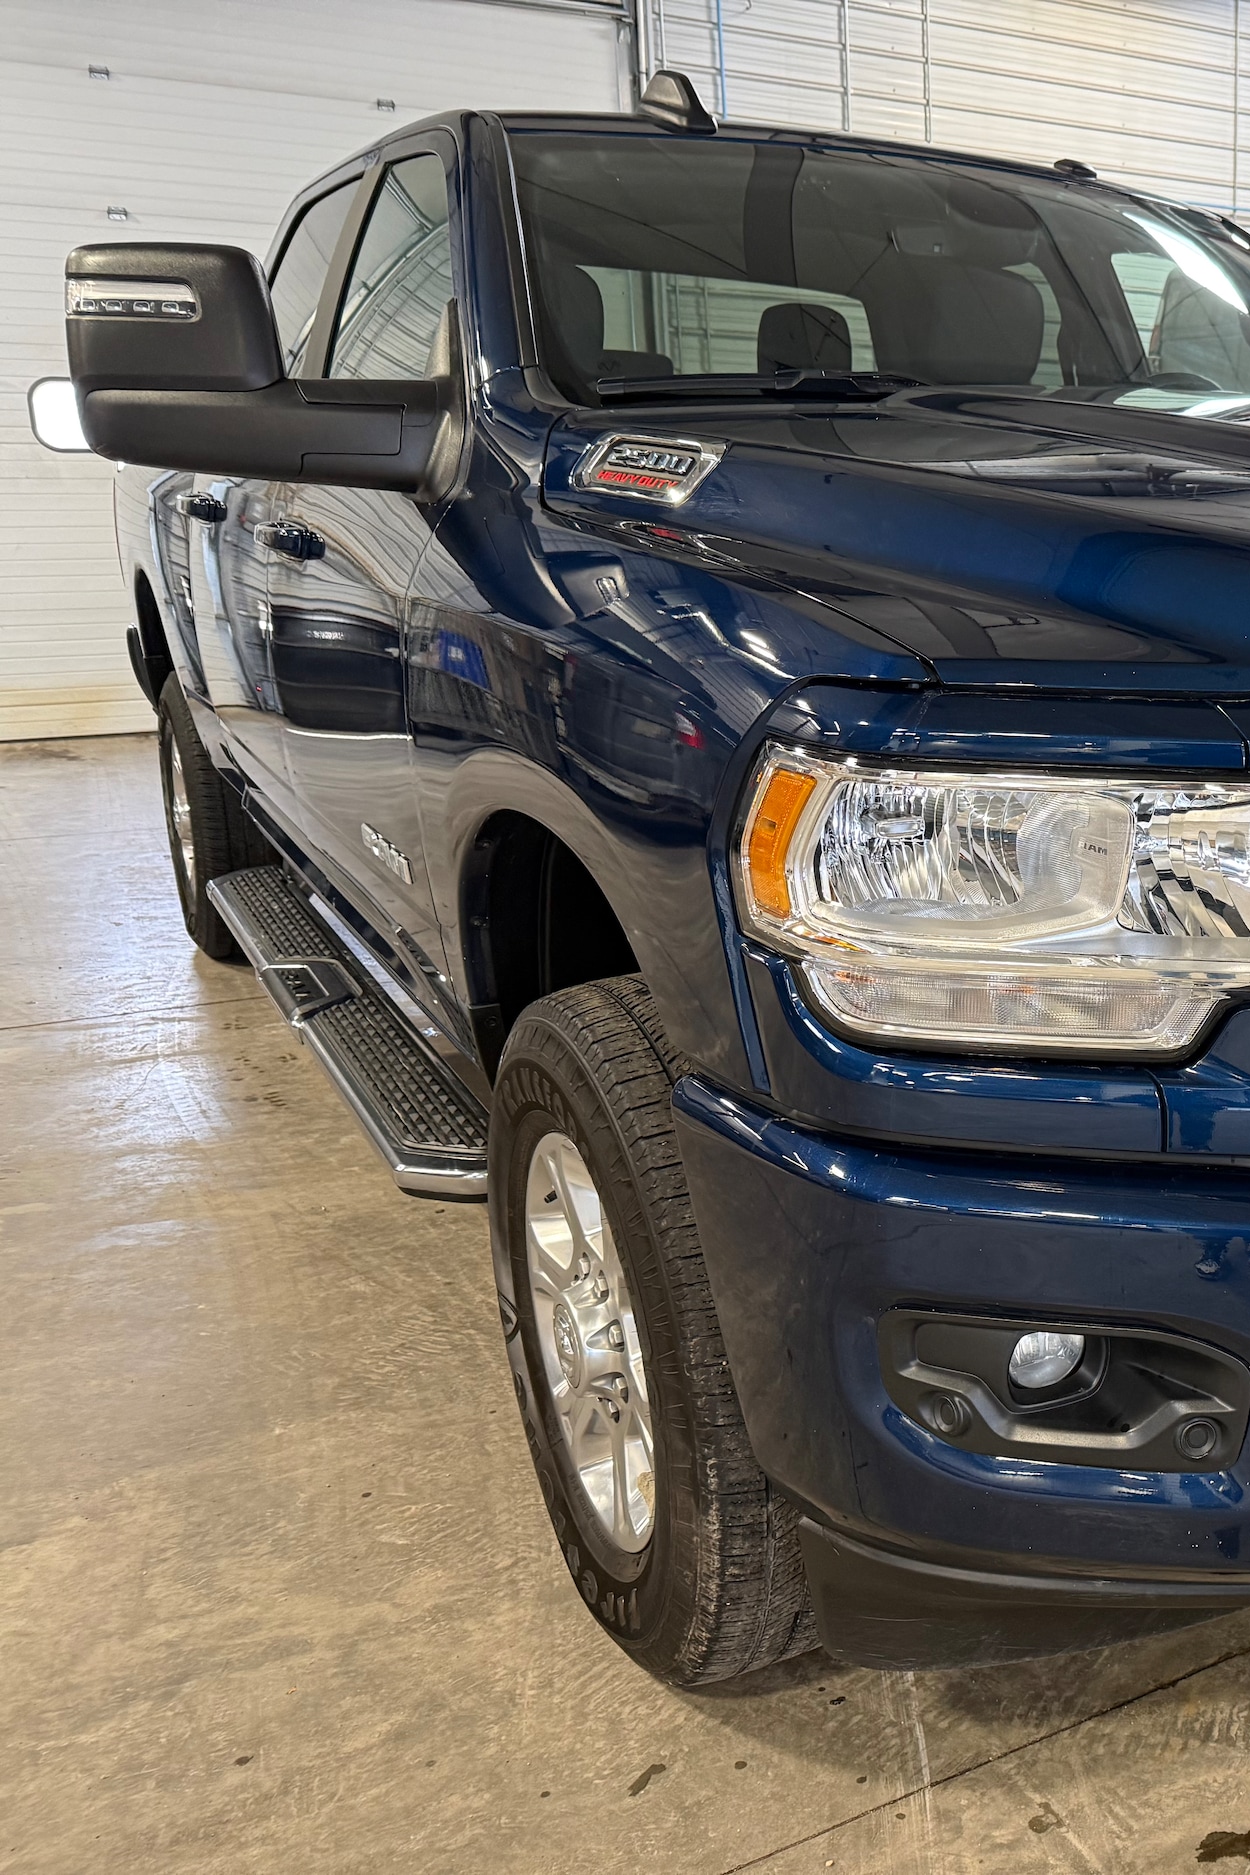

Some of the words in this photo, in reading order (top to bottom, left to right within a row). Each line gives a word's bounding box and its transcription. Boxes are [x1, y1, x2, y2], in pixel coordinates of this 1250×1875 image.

[607, 446, 697, 475] 2500
[595, 470, 638, 484] HEAVY
[637, 475, 678, 490] DUTY
[1078, 839, 1108, 856] RAM
